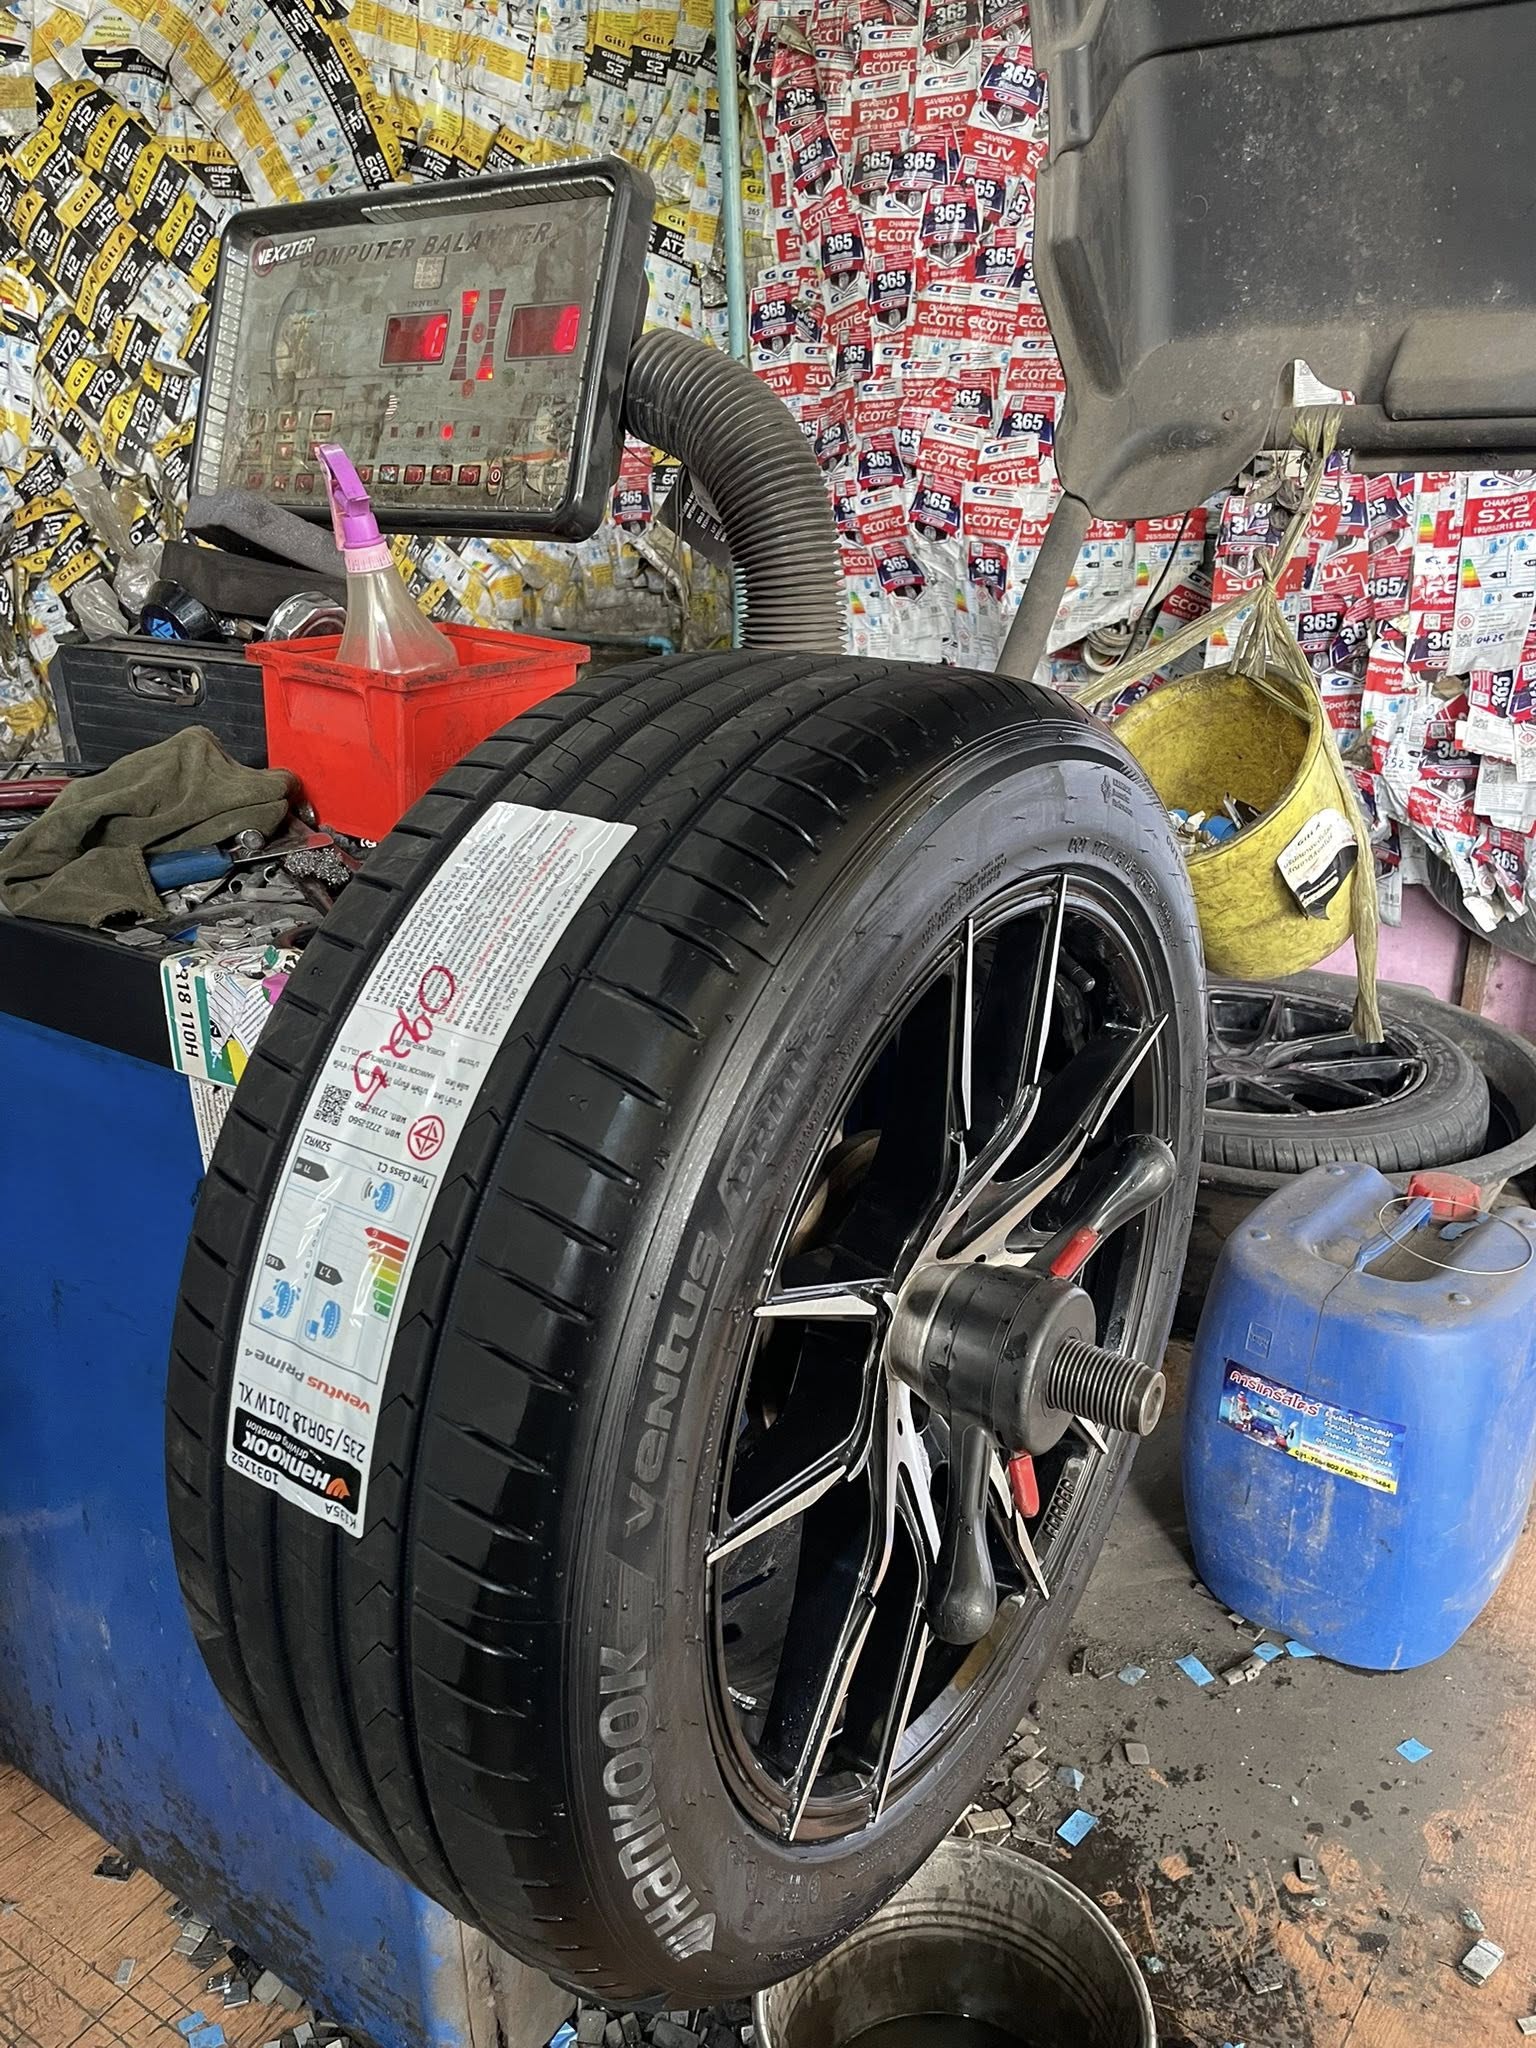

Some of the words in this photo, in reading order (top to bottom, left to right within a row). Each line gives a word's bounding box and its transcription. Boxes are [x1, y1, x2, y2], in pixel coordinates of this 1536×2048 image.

[287, 9, 309, 35] S2
[338, 38, 356, 64] Giti
[604, 34, 627, 49] Giti
[643, 33, 665, 45] Giti
[322, 60, 341, 85] S2
[605, 61, 625, 78] S2
[645, 60, 665, 75] S2
[862, 59, 917, 75] ECOTEC
[1001, 62, 1037, 88] 365
[56, 93, 72, 122] Giti
[75, 105, 96, 133] H2
[926, 103, 967, 121] PRO
[93, 131, 109, 158] Giti
[427, 133, 450, 149] Giti
[973, 140, 1016, 161] SUV
[27, 140, 48, 167] Giti
[114, 143, 133, 170] H2
[863, 151, 891, 172] 365
[903, 152, 936, 171] 365
[424, 157, 447, 177] H2
[133, 168, 149, 195] Giti
[155, 178, 174, 206] H2
[209, 174, 231, 188] S2
[73, 186, 94, 212] Giti
[95, 201, 117, 229] H2
[934, 203, 967, 223] 365
[36, 228, 54, 253] H2
[165, 216, 182, 243] Giti
[184, 223, 207, 257] P10
[257, 236, 317, 266] NEXZTER
[302, 238, 415, 267] COMPUTER
[826, 232, 853, 254] 365
[65, 254, 81, 280] H2
[100, 246, 119, 272] Giti
[985, 247, 1016, 267] 365
[122, 260, 140, 286] S2
[878, 270, 906, 291] 365
[81, 290, 93, 315] Giti
[759, 300, 786, 320] 365
[98, 304, 115, 329] H2
[53, 329, 81, 371] AT70
[131, 340, 148, 367] H2
[844, 345, 866, 362] 365
[73, 361, 92, 387] Giti
[87, 369, 117, 410] AT70
[136, 398, 156, 439] AT70
[1012, 412, 1044, 431] 365
[866, 450, 892, 468] 365
[980, 466, 1038, 484] ECOTEC
[620, 490, 642, 506] 365
[923, 489, 952, 511] 365
[965, 513, 1020, 530] ECOTEC
[1478, 502, 1530, 524] SX2
[58, 565, 81, 582] Giti
[882, 556, 909, 573] 365
[1303, 612, 1338, 632] 365
[1491, 675, 1511, 707] 365
[1493, 848, 1520, 873] 365
[181, 1010, 200, 1058] 110H
[304, 1134, 333, 1153] S2WR2
[377, 1161, 389, 1173] C1
[390, 1165, 411, 1182] Class
[412, 1175, 430, 1189] Tyre
[239, 1382, 254, 1406] XL
[255, 1392, 291, 1424] 101W
[246, 1419, 282, 1443] emotion
[293, 1411, 367, 1463] 235/50R18
[282, 1436, 309, 1460] driving
[232, 1450, 279, 1485] 1031752
[325, 1502, 357, 1530] K135A
